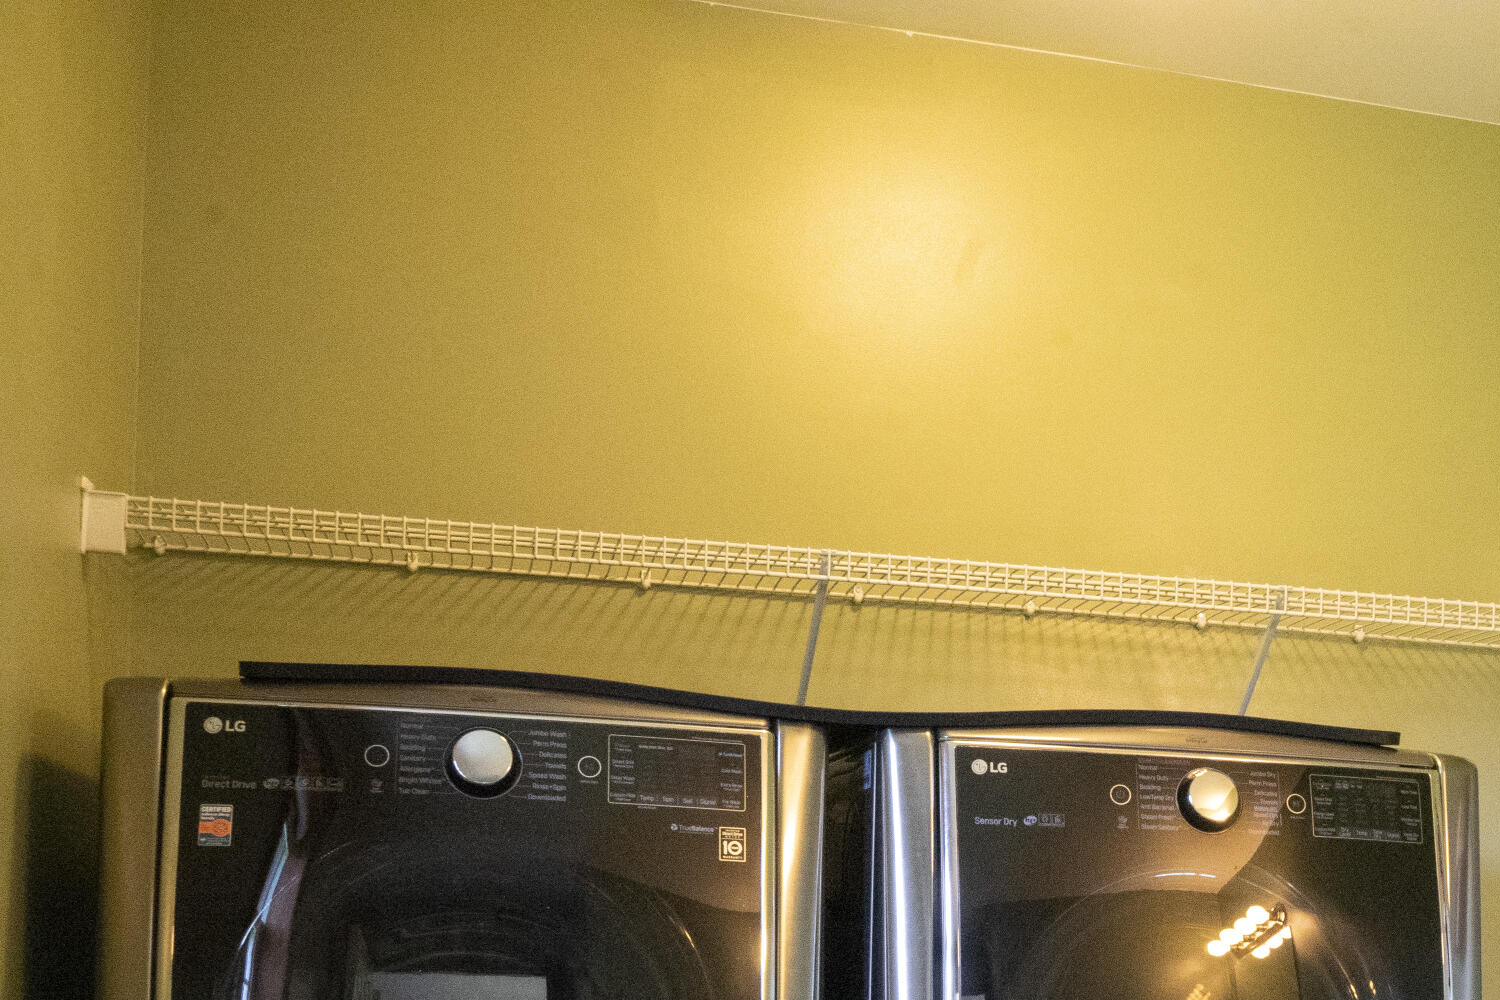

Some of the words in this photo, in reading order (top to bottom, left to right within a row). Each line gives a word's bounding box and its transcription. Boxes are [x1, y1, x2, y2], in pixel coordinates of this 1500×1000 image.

[225, 720, 246, 732] LG
[989, 761, 1008, 774] LG
[974, 816, 1002, 825] Sensor
[1003, 817, 1018, 827] Dry
[723, 840, 743, 856] 10
